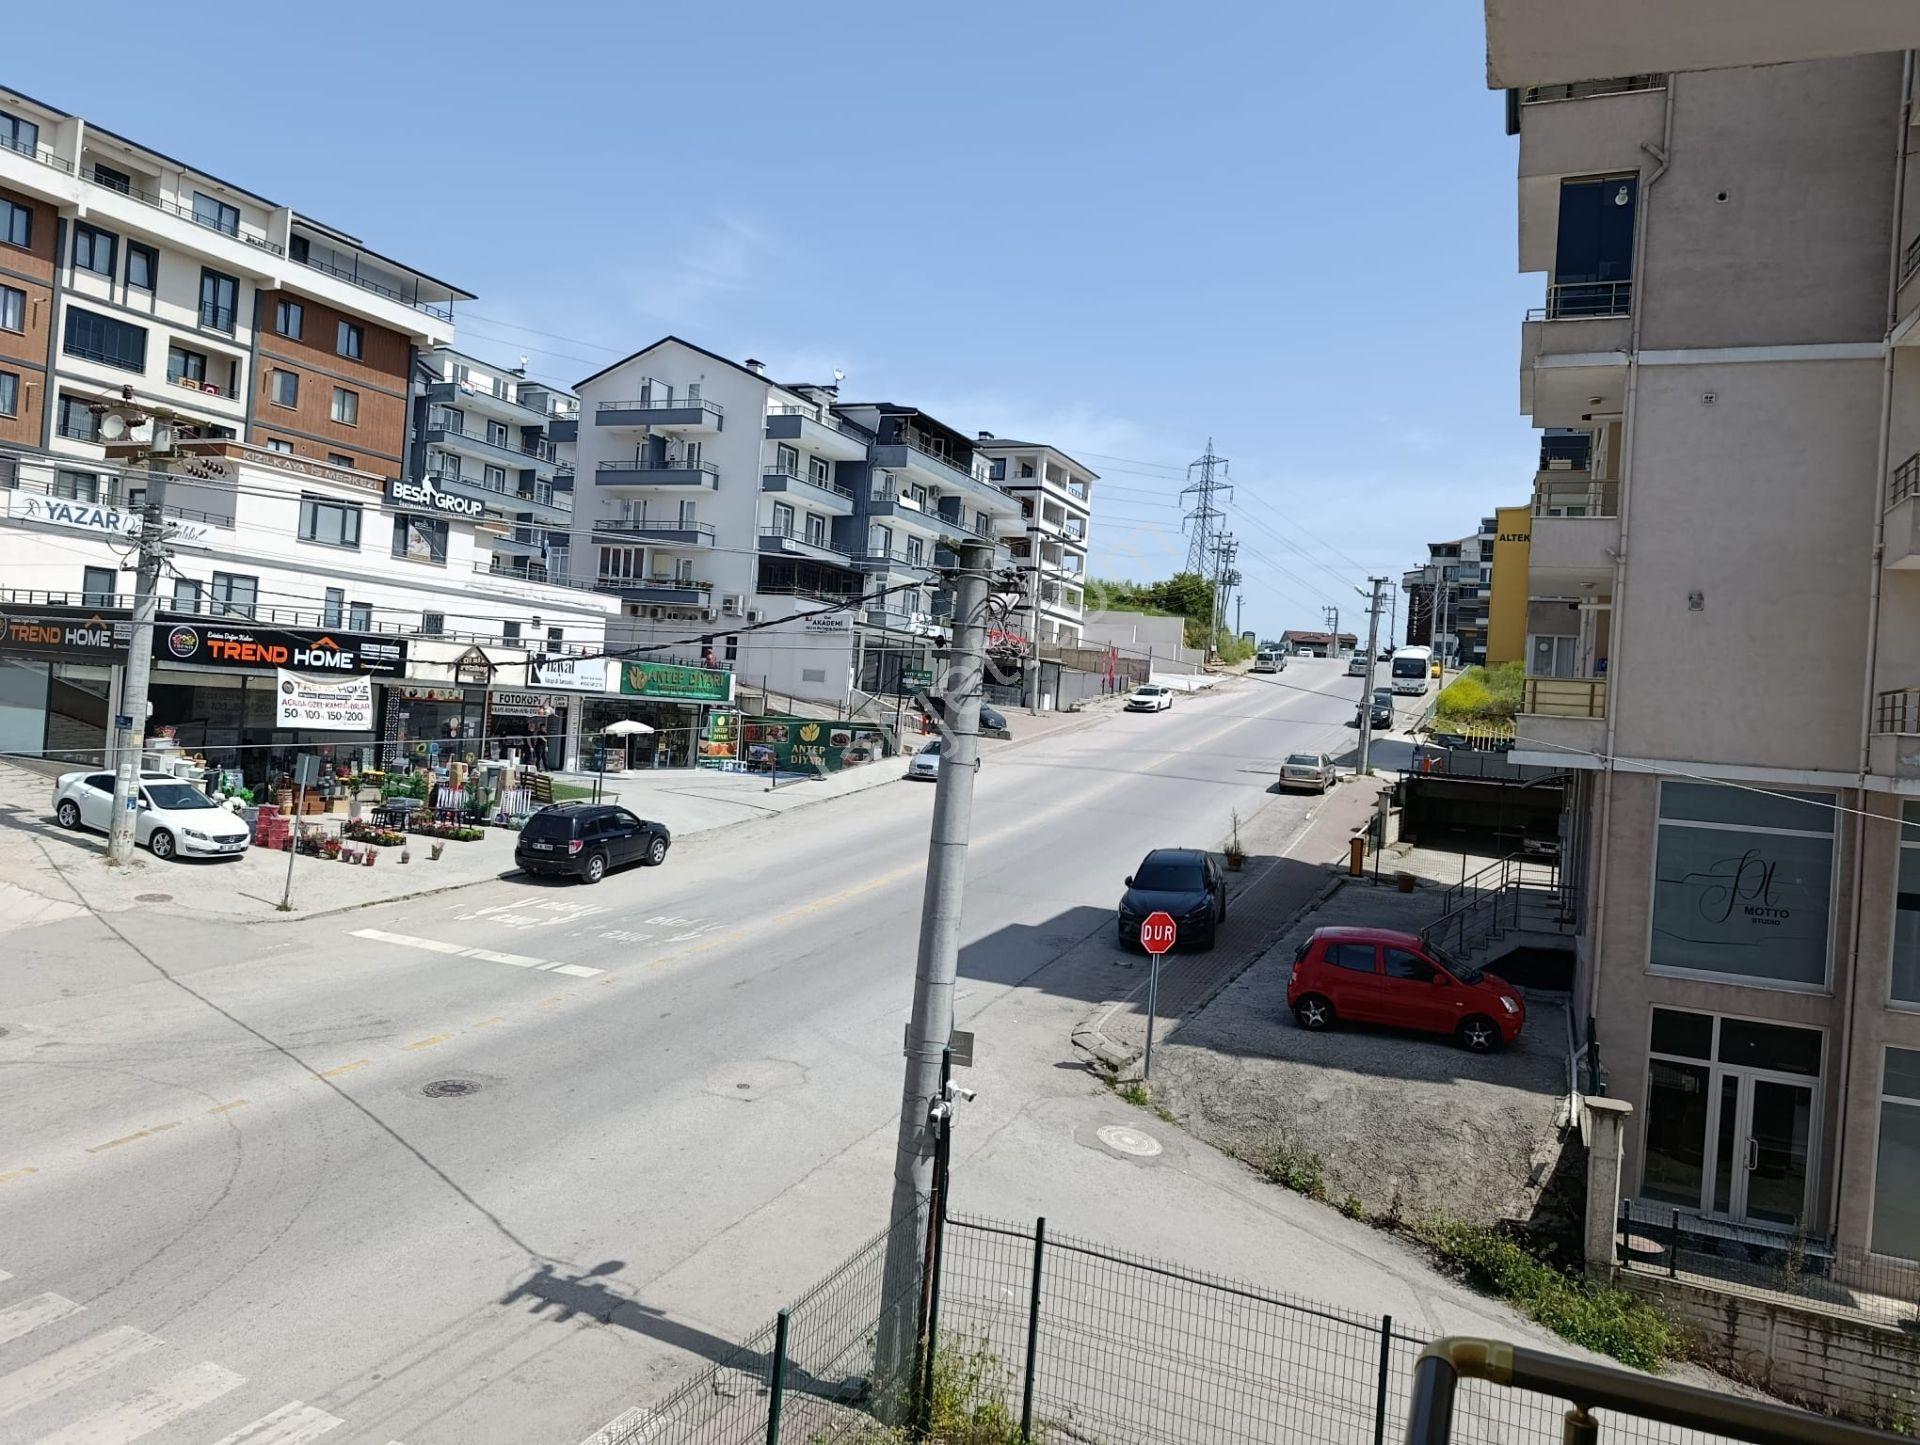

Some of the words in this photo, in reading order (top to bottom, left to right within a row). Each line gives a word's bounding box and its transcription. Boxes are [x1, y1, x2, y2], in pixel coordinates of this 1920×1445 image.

[392, 481, 431, 505] BESA
[434, 492, 482, 516] GROUP
[45, 501, 120, 531] YAZAR
[9, 624, 61, 644] TREND
[64, 627, 112, 648] HOME
[207, 640, 288, 664] TREND
[293, 648, 354, 669] HOME
[648, 670, 684, 684] ANTEP
[284, 708, 298, 718] 50
[305, 709, 321, 720] 100
[327, 711, 342, 721] 150
[346, 711, 364, 722] 200
[791, 744, 826, 755] ANTEP
[1744, 906, 1790, 919] MOTTO
[1752, 917, 1781, 926] STUDIO
[1143, 925, 1173, 941] DUR
